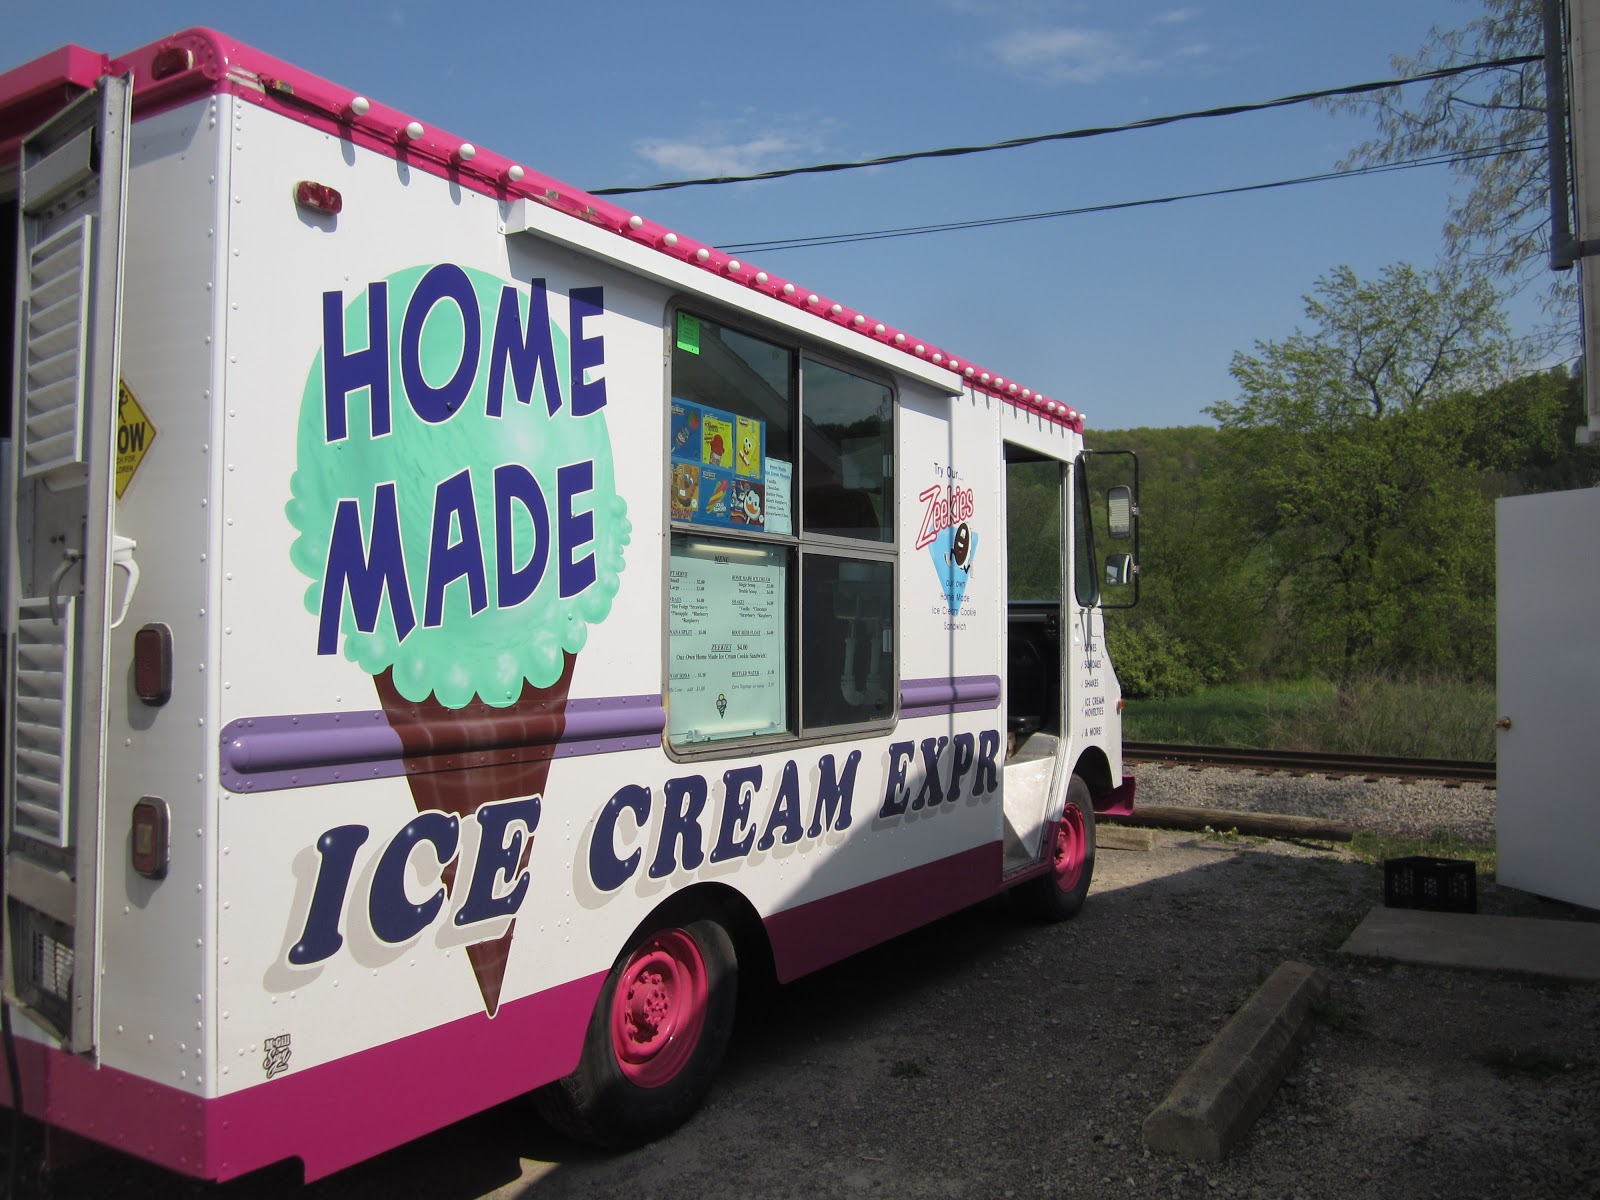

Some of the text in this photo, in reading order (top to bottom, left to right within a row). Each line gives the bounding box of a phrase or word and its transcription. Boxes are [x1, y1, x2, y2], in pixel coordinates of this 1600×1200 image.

[322, 262, 607, 444] HOME
[933, 463, 944, 478] Try
[915, 484, 974, 551] Zeekies
[317, 459, 597, 655] MADE
[957, 593, 969, 602] Made
[932, 606, 976, 617] Ice Cream Cookie
[944, 621, 966, 630] Sandwich
[1085, 679, 1099, 688] SHAKES
[1092, 696, 1105, 705] CREAM
[1085, 707, 1104, 717] NOVELTIES
[288, 729, 1000, 965] ICE CREAM EXPR
